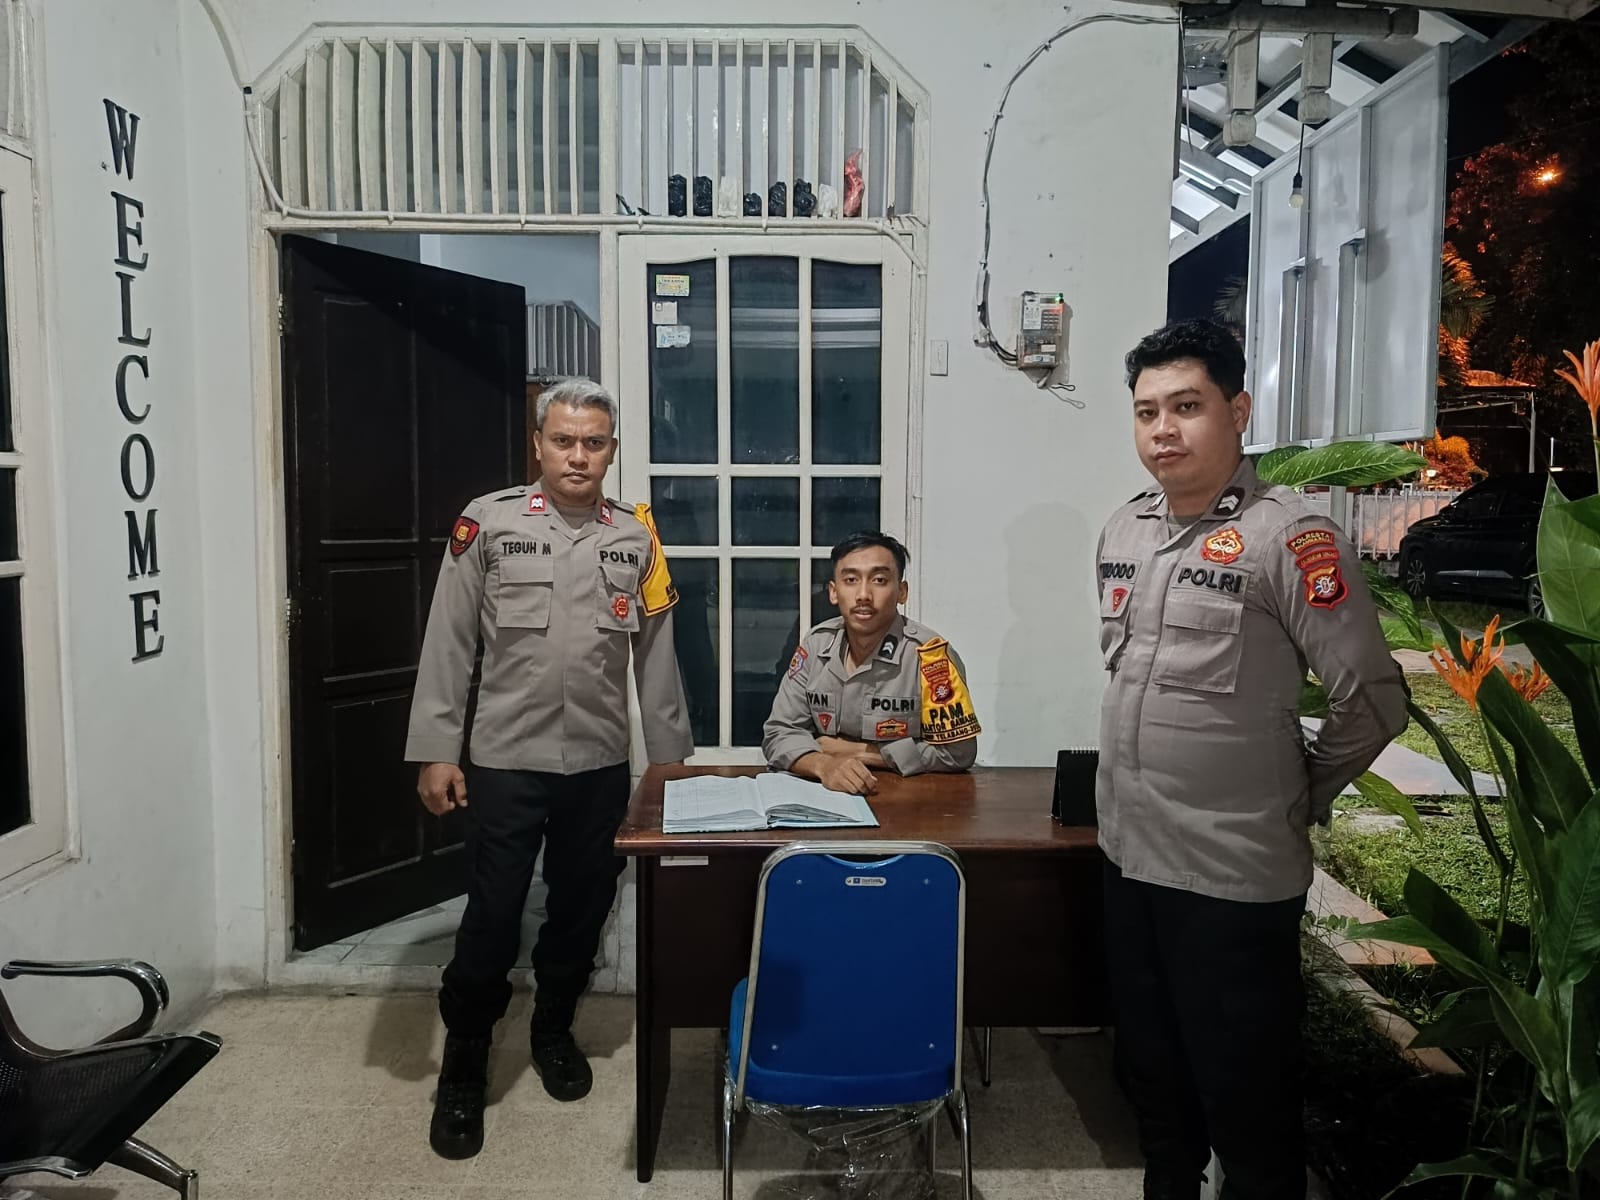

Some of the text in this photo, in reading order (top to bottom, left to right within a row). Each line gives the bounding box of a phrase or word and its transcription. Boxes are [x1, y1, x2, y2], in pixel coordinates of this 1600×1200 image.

[103, 97, 165, 664] WELCOME
[502, 541, 537, 556] TEGUH
[600, 550, 639, 567] POLRI
[1178, 567, 1243, 594] POLRI
[871, 698, 915, 712] POLRI
[929, 702, 963, 723] PAM
